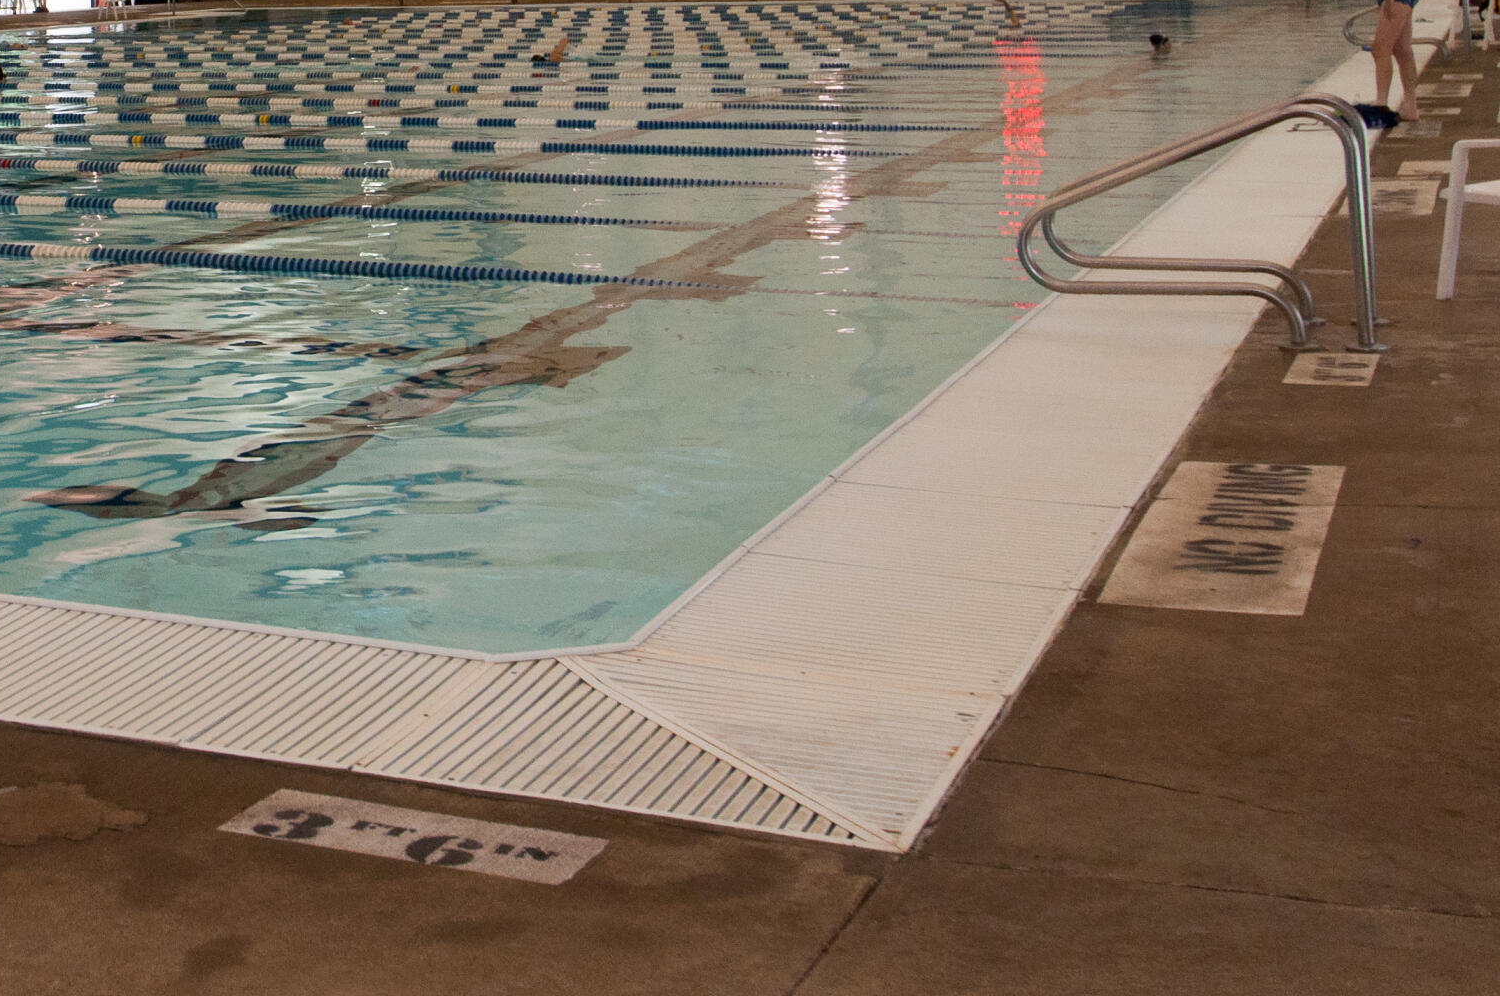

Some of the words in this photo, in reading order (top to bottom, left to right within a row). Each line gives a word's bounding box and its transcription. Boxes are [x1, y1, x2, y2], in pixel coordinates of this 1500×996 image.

[1197, 464, 1313, 531] DIVING
[1173, 538, 1286, 575] NO
[253, 809, 334, 839] 3
[405, 835, 483, 866] 6
